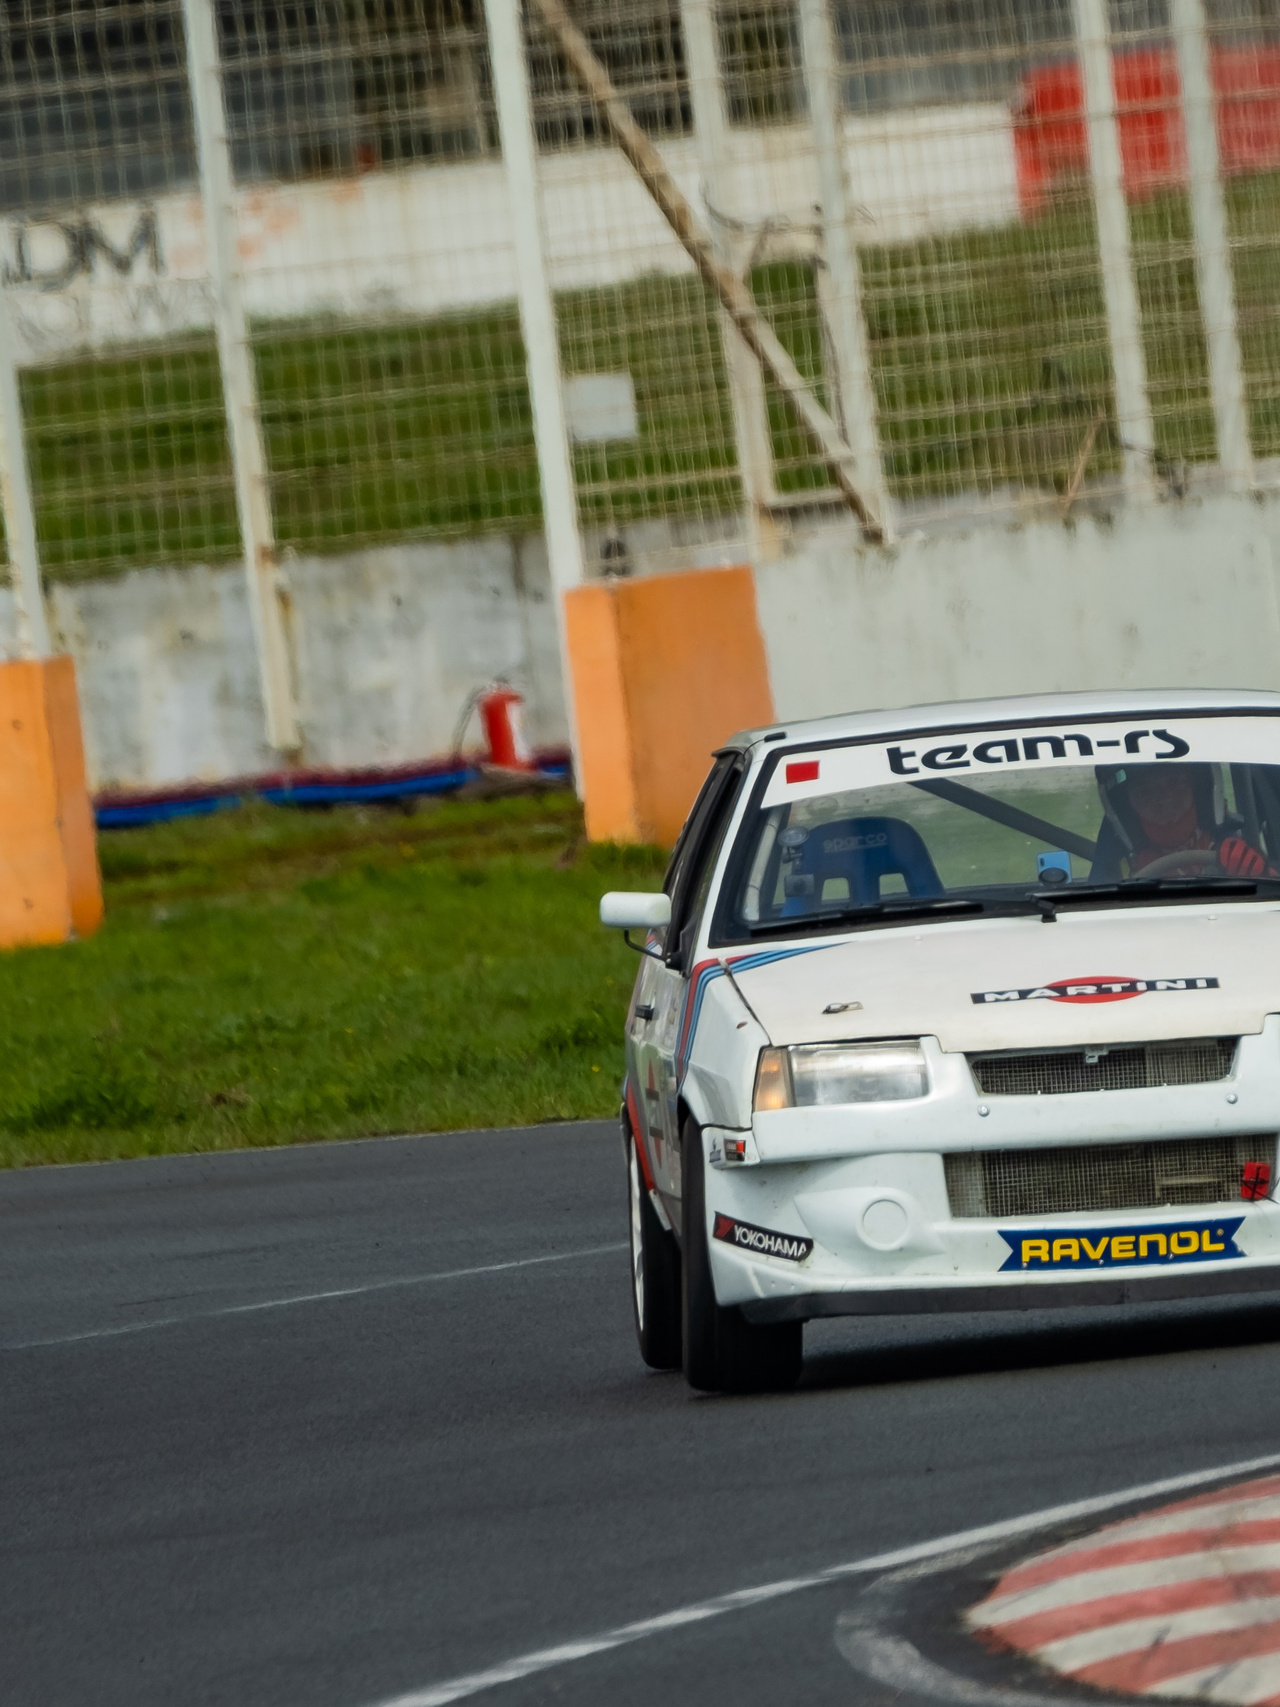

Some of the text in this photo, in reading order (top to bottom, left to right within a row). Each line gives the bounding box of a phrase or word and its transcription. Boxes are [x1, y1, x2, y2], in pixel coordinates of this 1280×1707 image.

[886, 729, 1190, 775] team-rs
[822, 832, 888, 851] sparco
[984, 979, 1208, 1002] MARTINI
[734, 1224, 807, 1258] YOKOHAMA
[1021, 1229, 1225, 1263] RAVENOL
